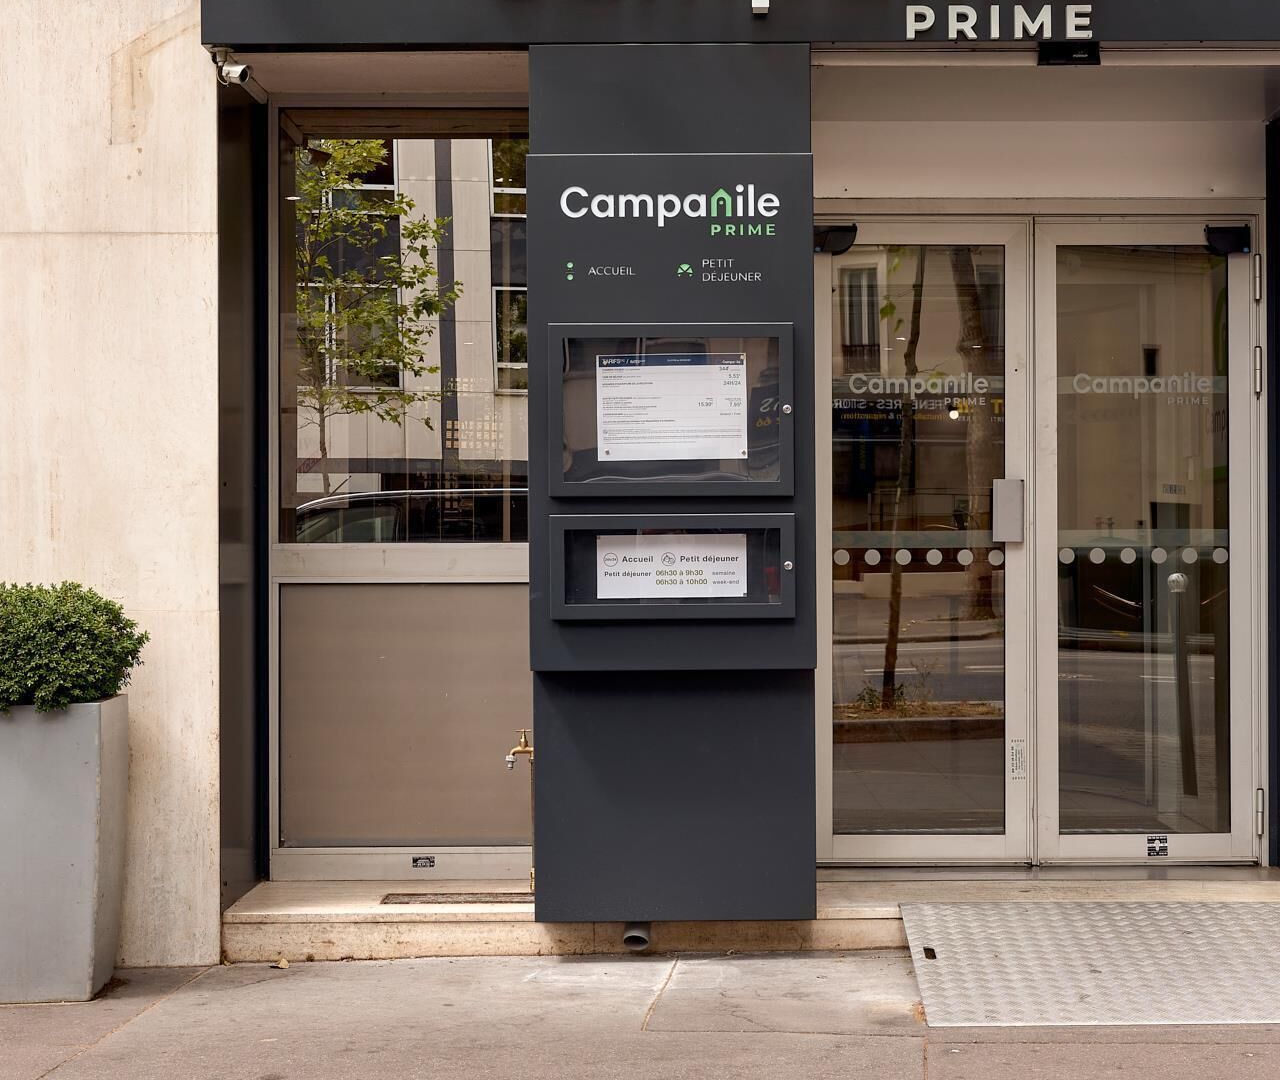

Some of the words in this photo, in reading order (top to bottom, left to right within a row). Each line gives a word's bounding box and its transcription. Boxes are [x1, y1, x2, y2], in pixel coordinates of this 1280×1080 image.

[906, 4, 1093, 41] PRIME
[560, 184, 780, 227] Campanile
[710, 224, 776, 236] PRIME
[702, 259, 735, 268] PETIT
[588, 266, 636, 276] ACCUEIL
[702, 270, 762, 282] DÉJEUNER
[848, 372, 989, 399] Campanile
[1072, 373, 1211, 398] Campanile
[944, 397, 987, 406] PRIME
[1167, 397, 1209, 406] PRIME
[622, 555, 654, 563] Accueil
[680, 555, 700, 563] Petit
[702, 554, 739, 564] déjeuner
[622, 570, 651, 578] déjeuner
